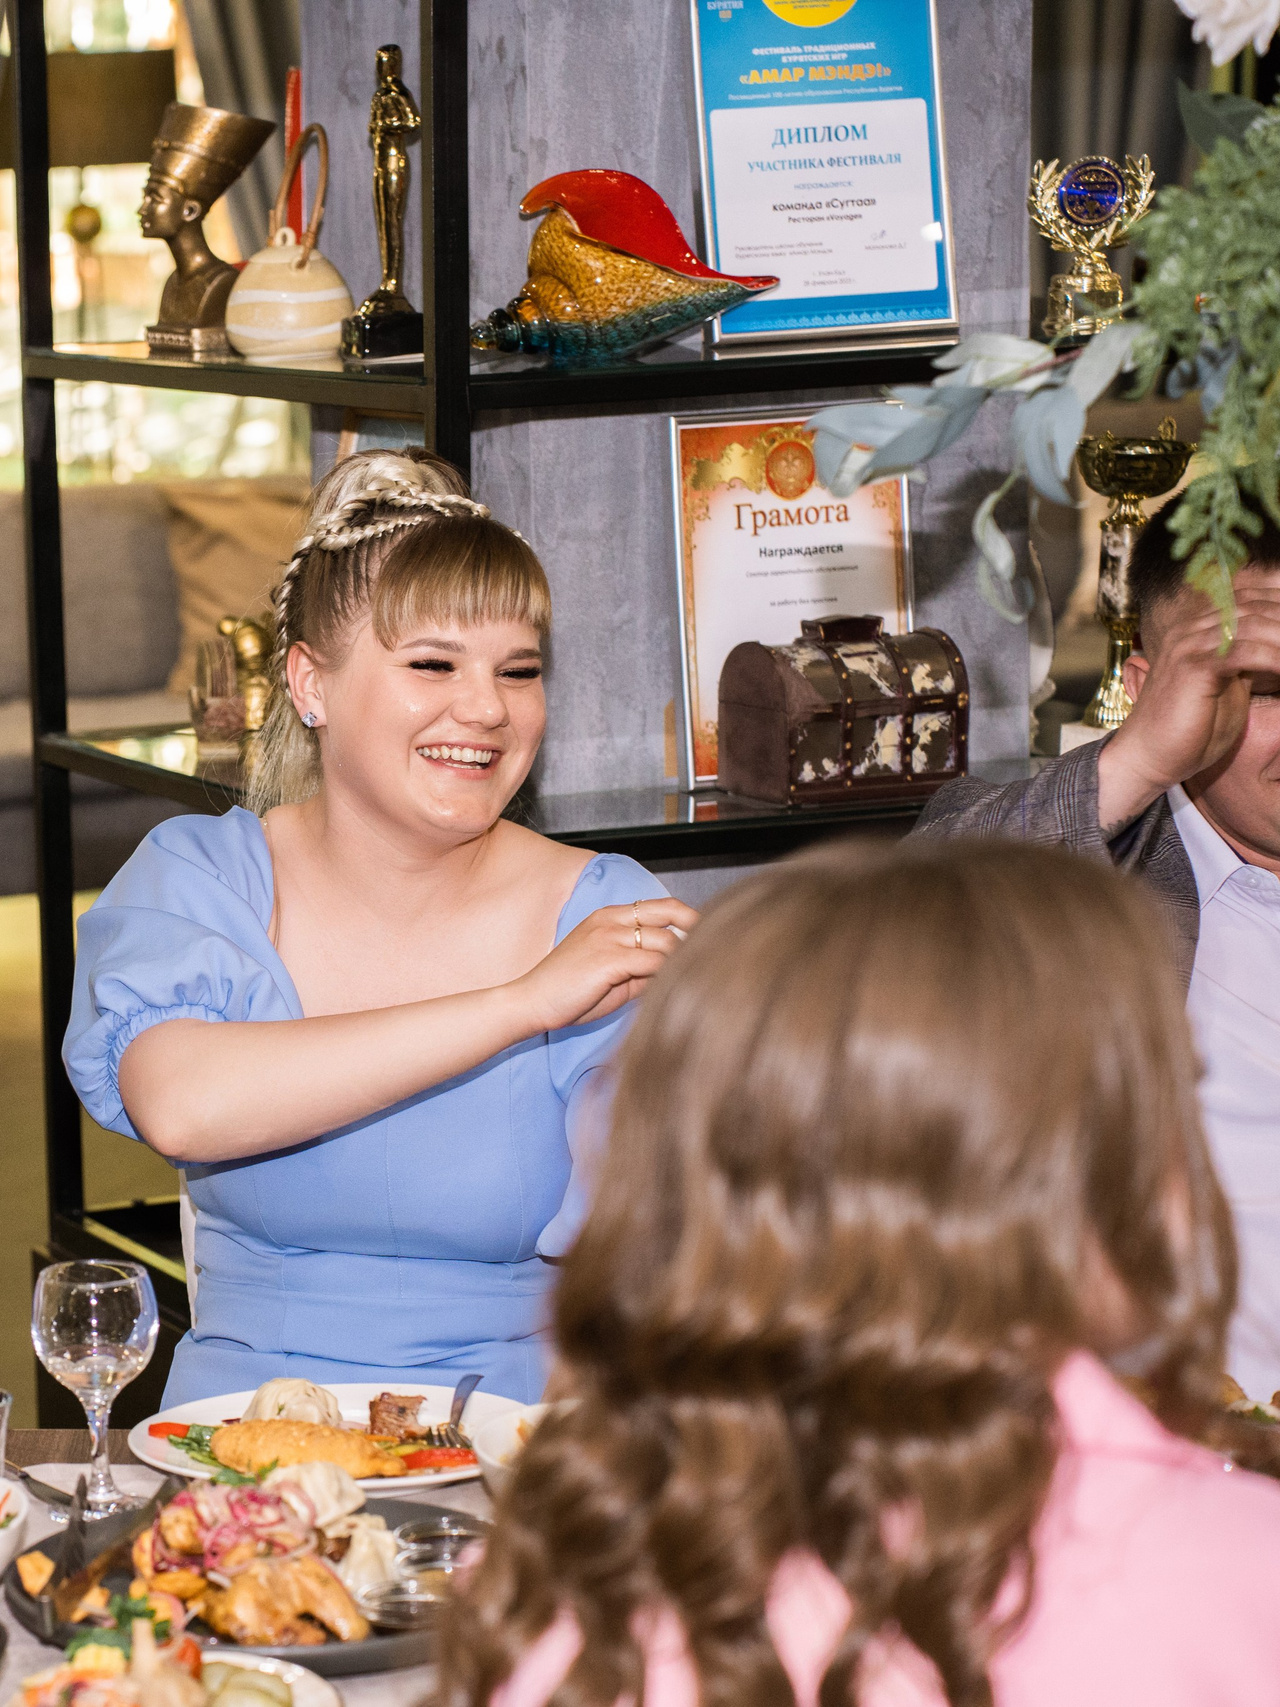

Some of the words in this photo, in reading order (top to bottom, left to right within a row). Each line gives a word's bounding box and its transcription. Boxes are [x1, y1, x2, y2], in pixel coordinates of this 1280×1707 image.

[707, 0, 744, 10] БУРЯТИЯ
[752, 47, 802, 56] ФЕСТИВАЛЬ
[803, 42, 876, 53] ТРАДИЦИОННЫХ
[781, 54, 830, 63] БУРЯТСКИХ
[831, 53, 848, 61] ИГР
[740, 67, 805, 84] «АМАР
[809, 63, 891, 81] МЭНДЭ!»
[771, 124, 868, 148] ДИПЛОМ
[747, 157, 825, 172] УЧАСТНИКА
[827, 153, 902, 168] ФЕСТИВАЛЯ
[772, 200, 822, 212] команда
[788, 215, 825, 223] Ресторан
[826, 213, 862, 221] «Voyage»
[734, 503, 850, 537] Грамота
[759, 544, 844, 558] Награждается
